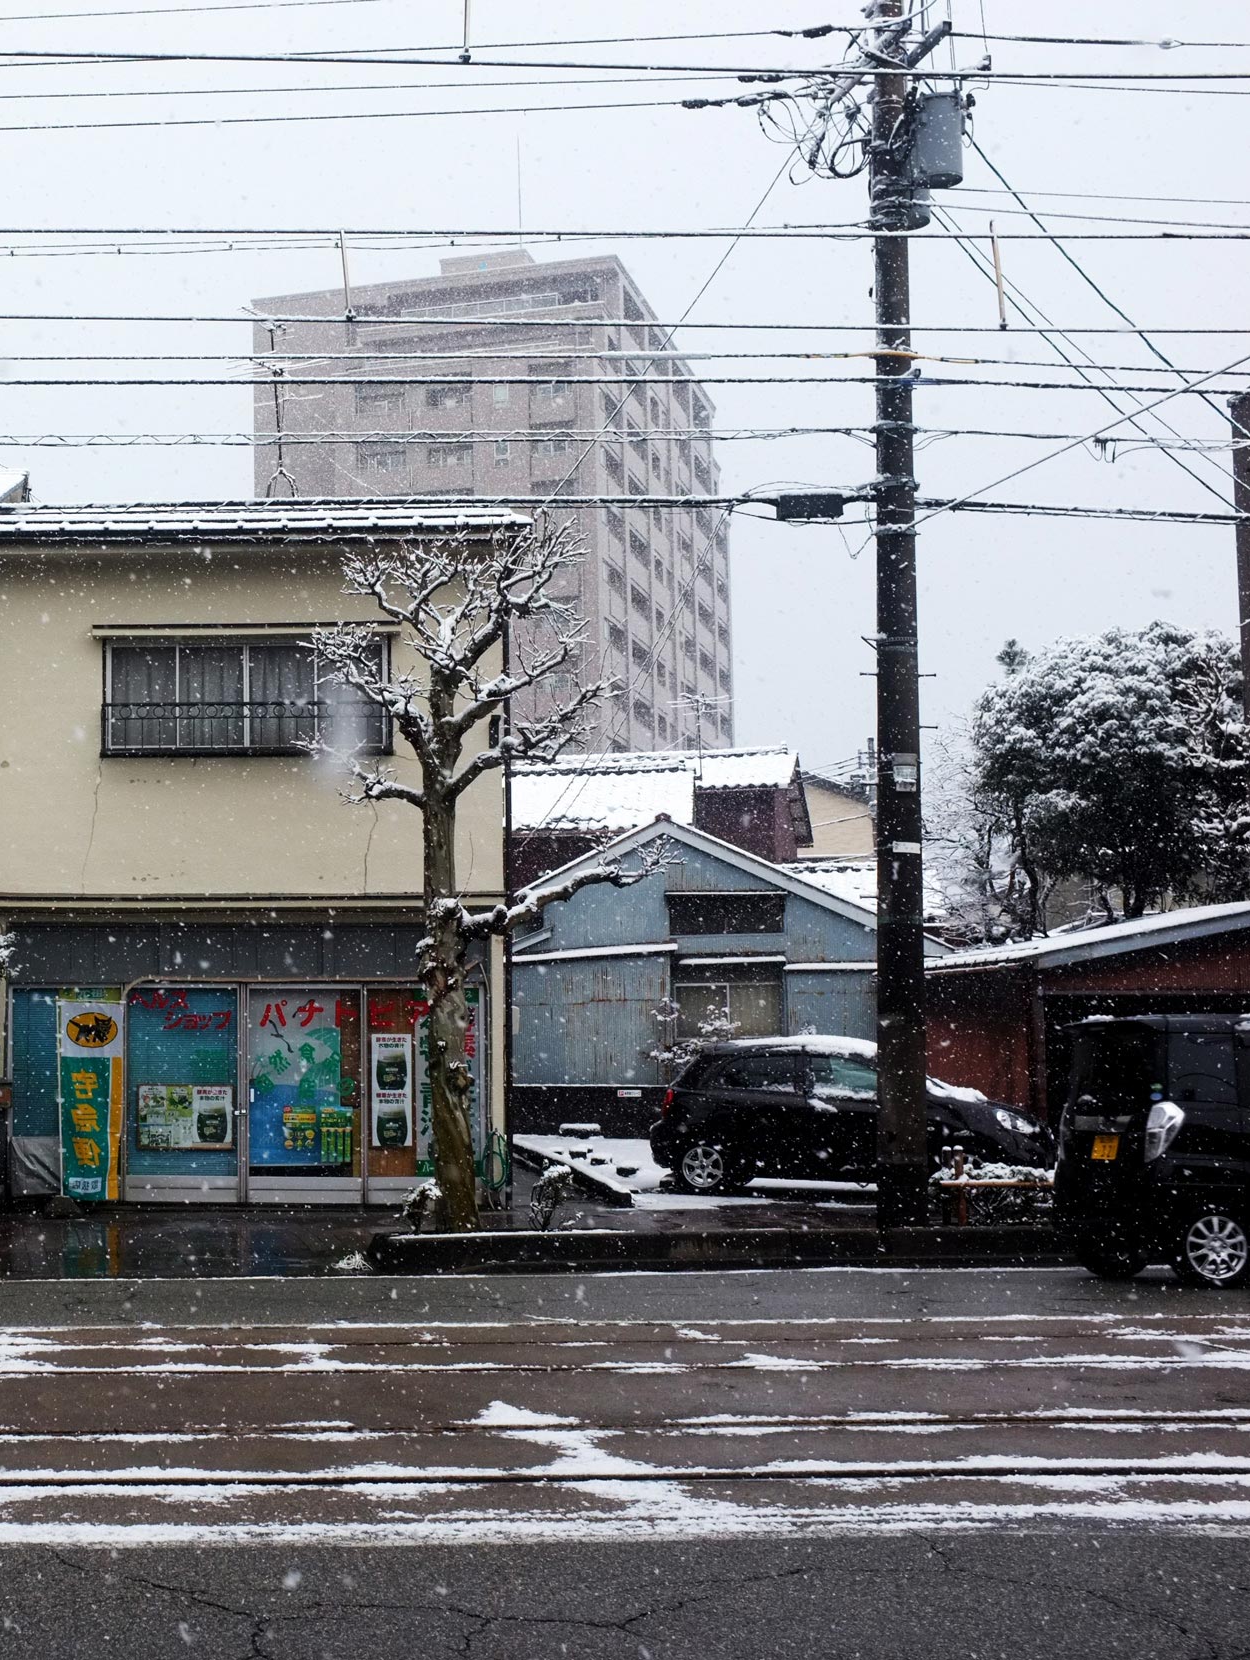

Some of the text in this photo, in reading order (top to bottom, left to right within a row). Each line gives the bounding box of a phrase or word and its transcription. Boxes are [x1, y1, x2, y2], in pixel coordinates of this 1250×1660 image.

[128, 990, 190, 1010] ヘルス
[259, 997, 430, 1028] パナトピア
